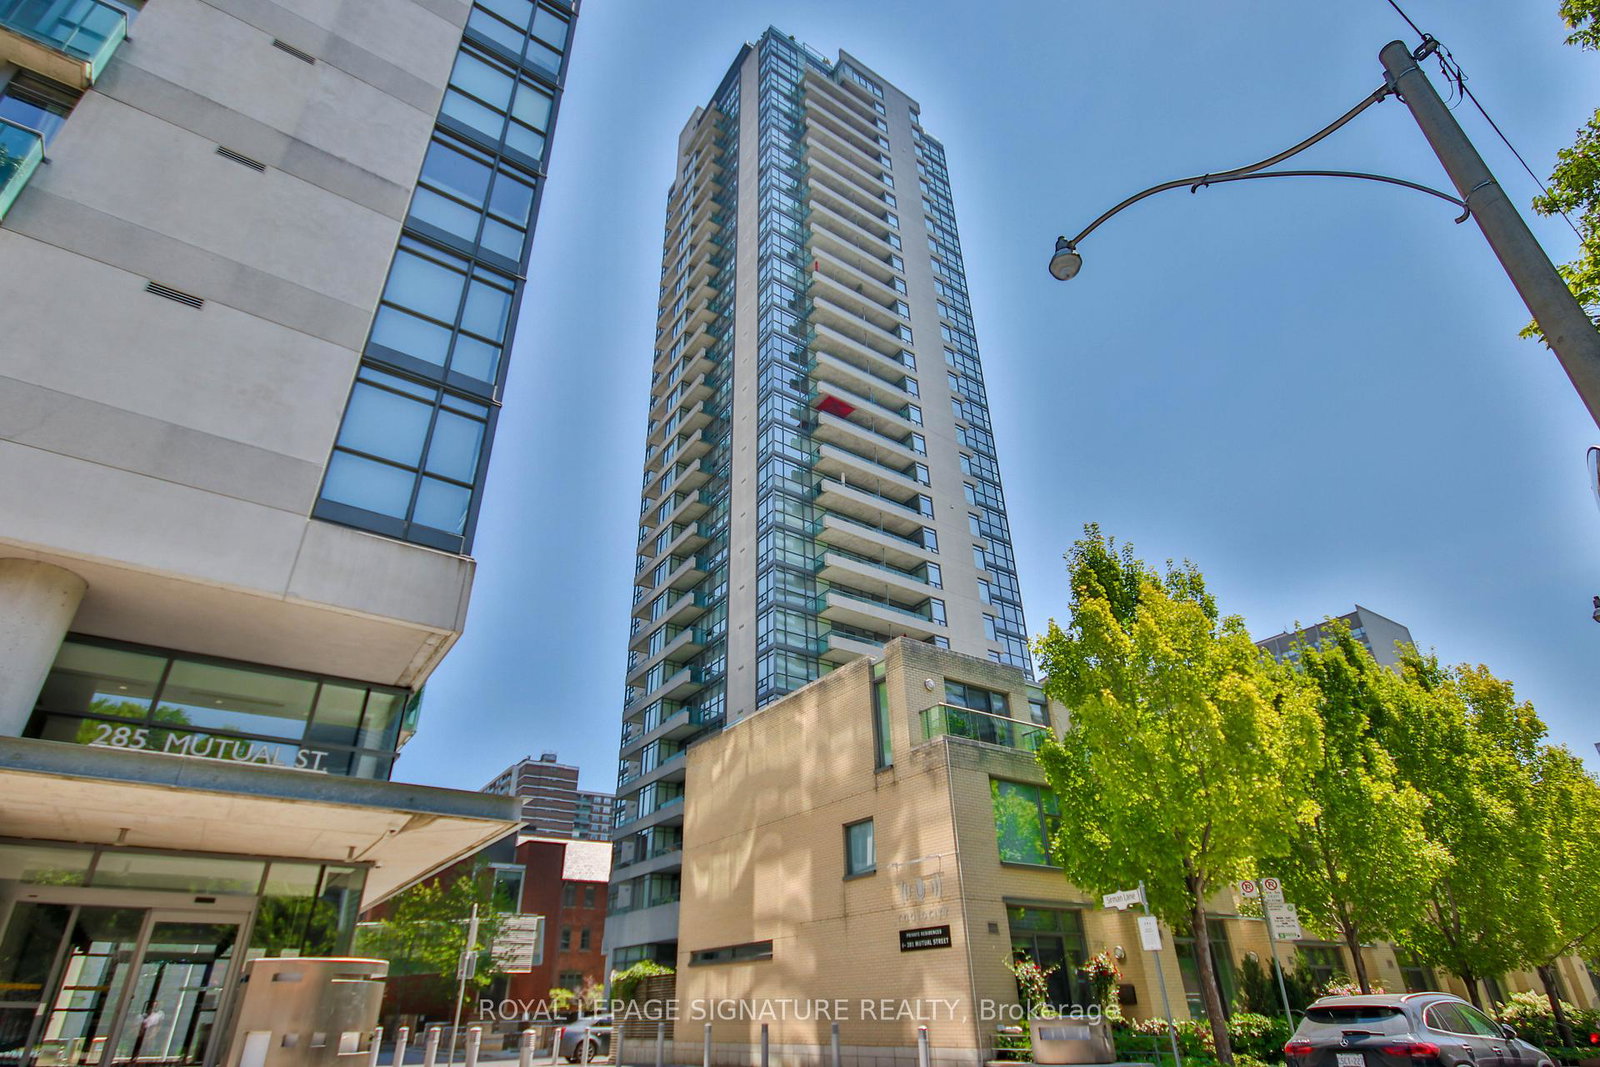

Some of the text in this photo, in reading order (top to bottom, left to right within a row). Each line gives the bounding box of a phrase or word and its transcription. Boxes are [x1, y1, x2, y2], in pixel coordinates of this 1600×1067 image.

[92, 723, 150, 749] 285
[163, 732, 286, 767] MUTUAL
[915, 939, 932, 947] MUTUAL
[932, 937, 949, 945] STREET
